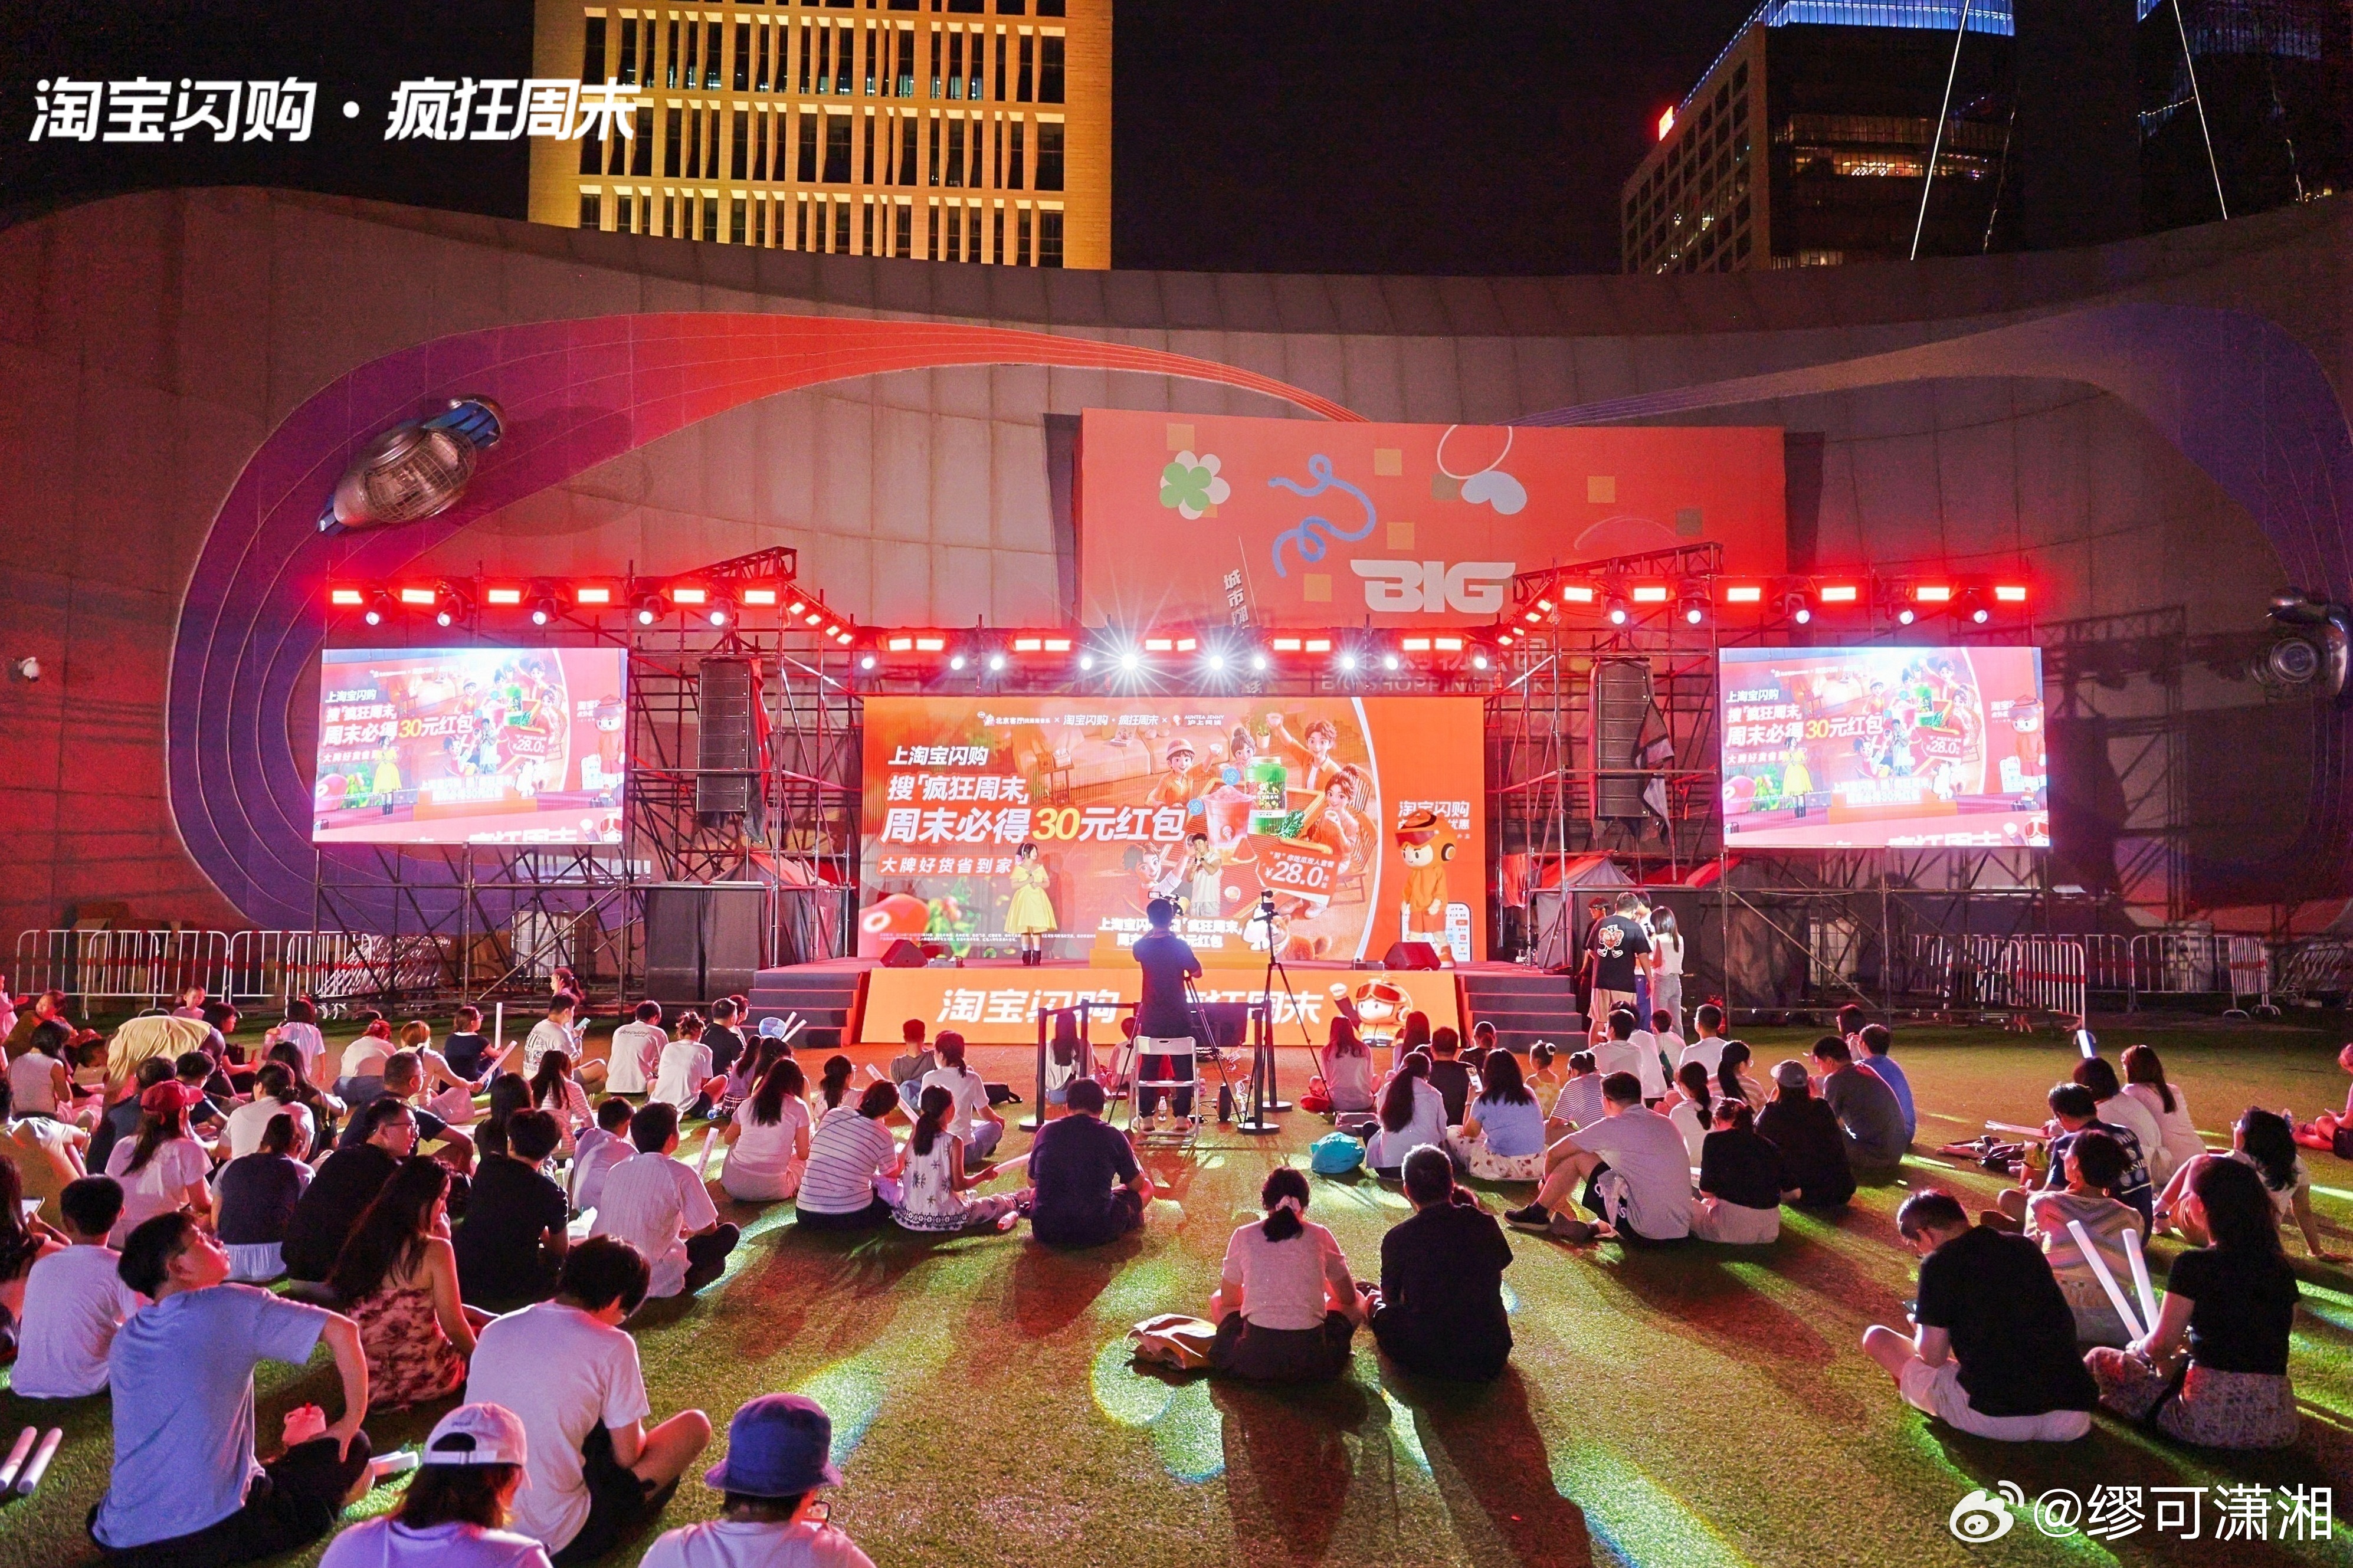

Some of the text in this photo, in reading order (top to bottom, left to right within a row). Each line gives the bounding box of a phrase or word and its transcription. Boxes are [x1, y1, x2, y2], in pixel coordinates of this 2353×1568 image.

[1350, 559, 1516, 613] BIG
[888, 746, 988, 766] 上淘宝闪购
[880, 806, 1187, 844] 周末必得30元红包
[880, 857, 1013, 874] 大牌好货省到家
